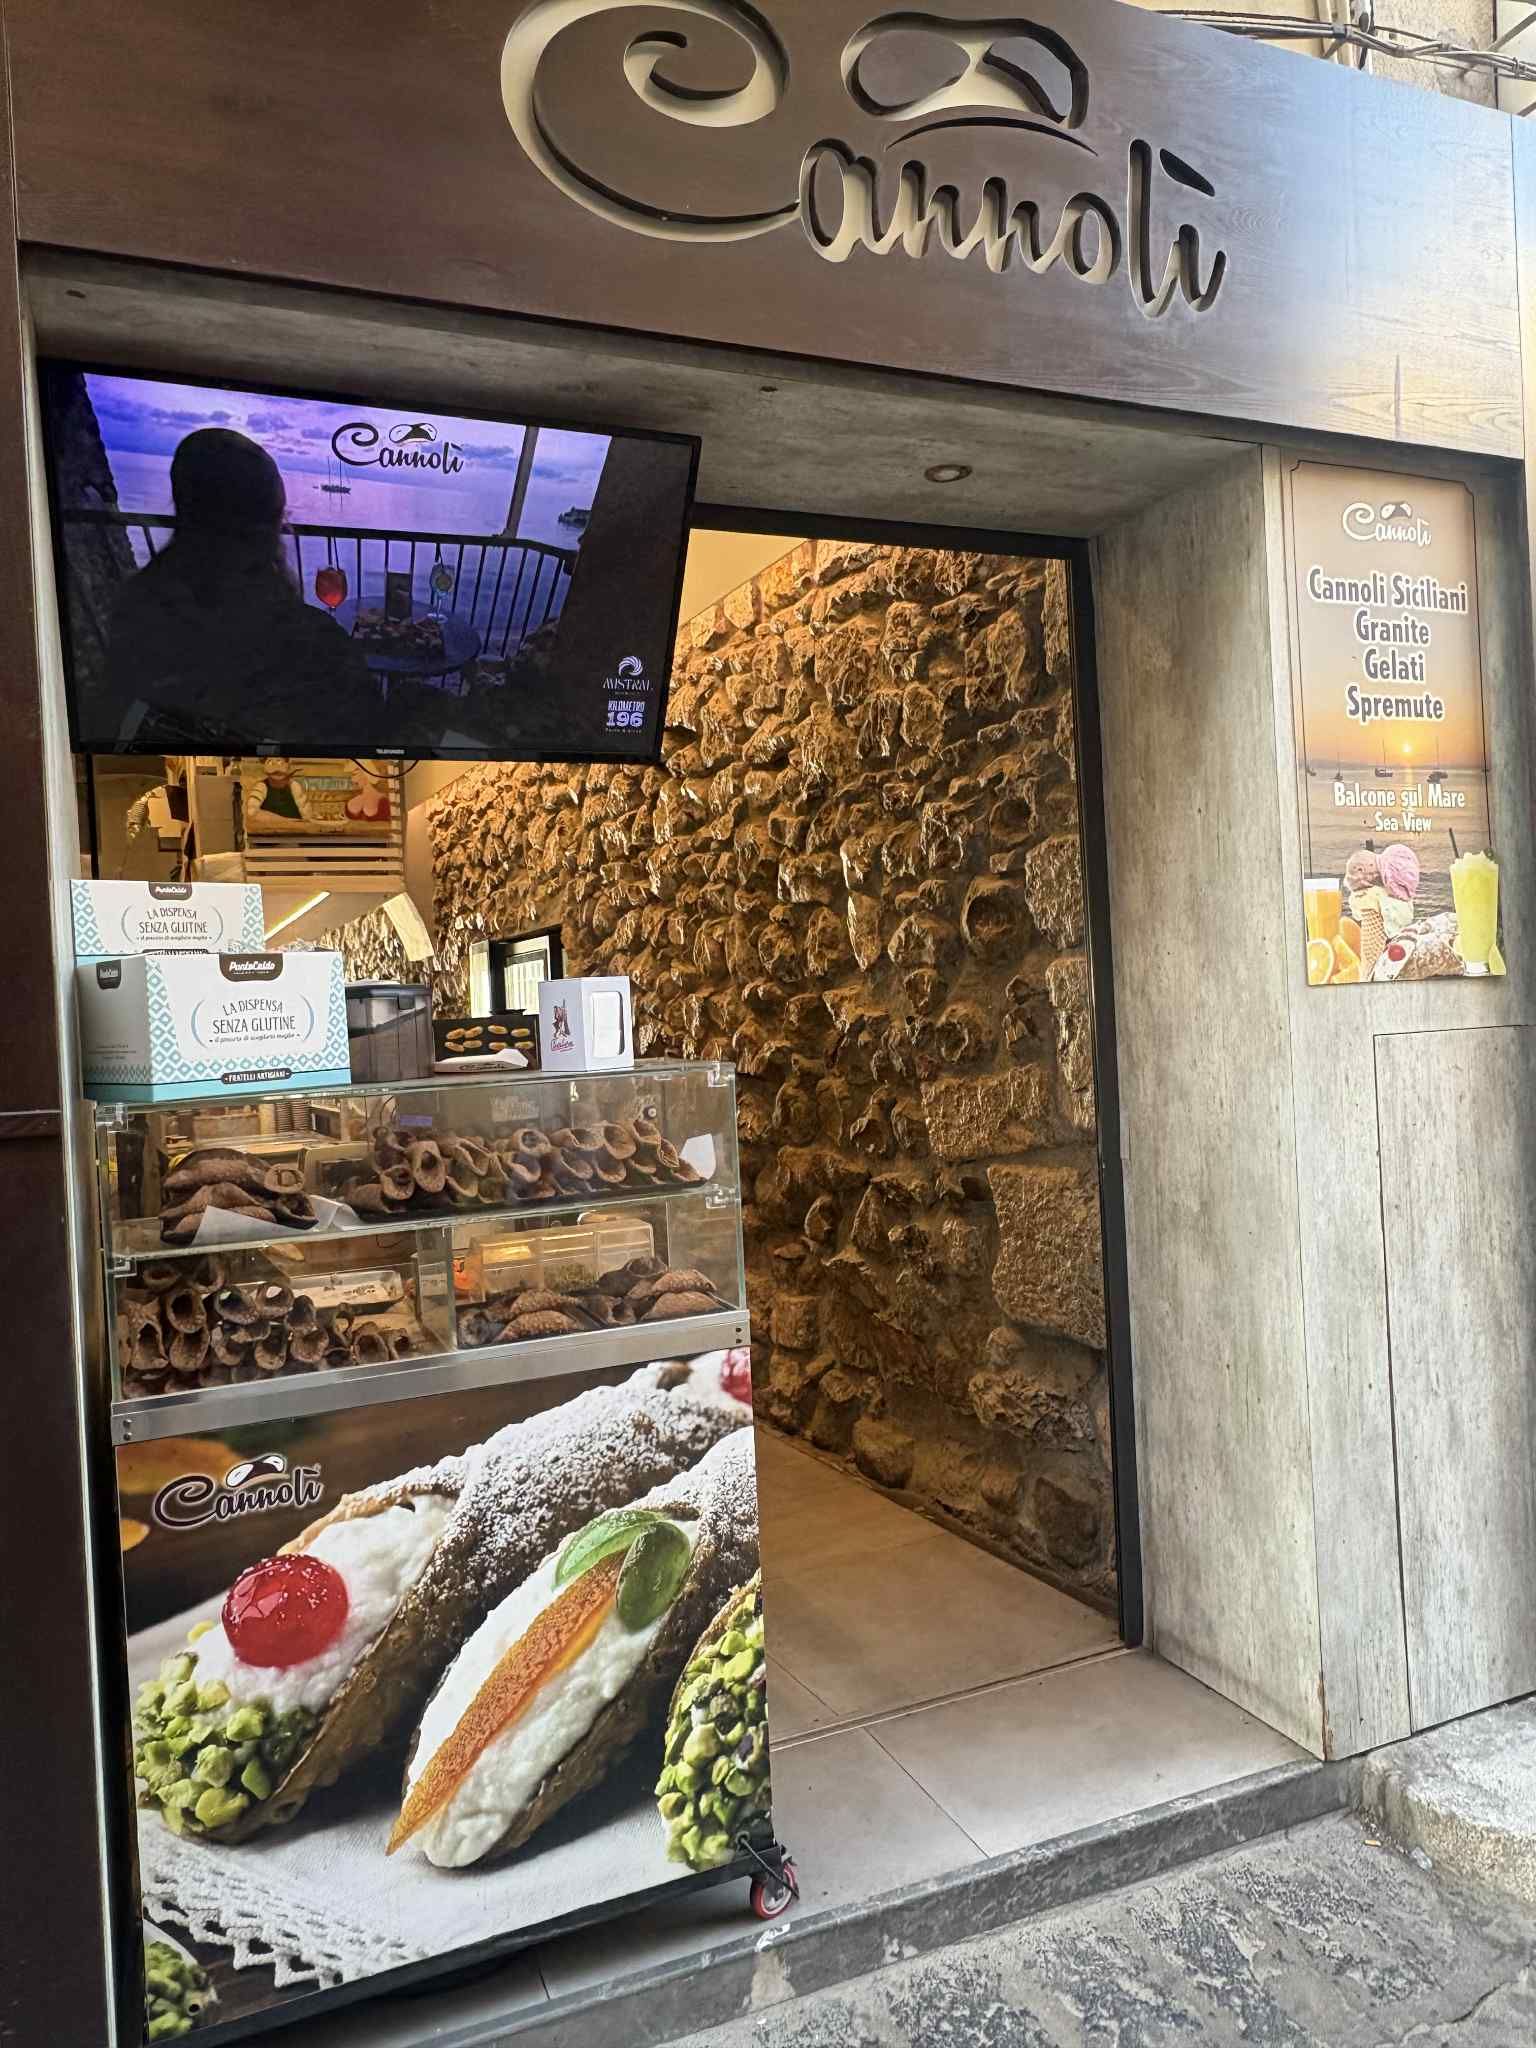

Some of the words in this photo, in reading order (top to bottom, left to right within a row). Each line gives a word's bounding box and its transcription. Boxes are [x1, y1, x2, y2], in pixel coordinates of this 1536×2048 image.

[1309, 568, 1386, 605] Cannoli
[1393, 574, 1467, 612] Siciliani
[1356, 609, 1430, 645] Granite
[1364, 648, 1425, 682] Gelati
[1347, 685, 1444, 723] Spremute
[606, 711, 643, 727] 196
[1334, 782, 1396, 807] Balcone
[1401, 784, 1422, 807] sul
[1428, 783, 1465, 808] Mare
[1375, 811, 1398, 832] Sea
[1403, 812, 1432, 832] View
[147, 909, 159, 920] LA
[160, 907, 198, 919] DISPENSA
[139, 921, 169, 934] SENZA
[171, 921, 208, 933] GLUTINE
[222, 1003, 237, 1016] LA
[238, 998, 283, 1013] DISPENSA
[212, 1018, 248, 1034] SENZA
[251, 1015, 296, 1032] GLUTINE
[229, 1073, 256, 1082] FRATELLI
[257, 1071, 286, 1081] ARTIGIANI
